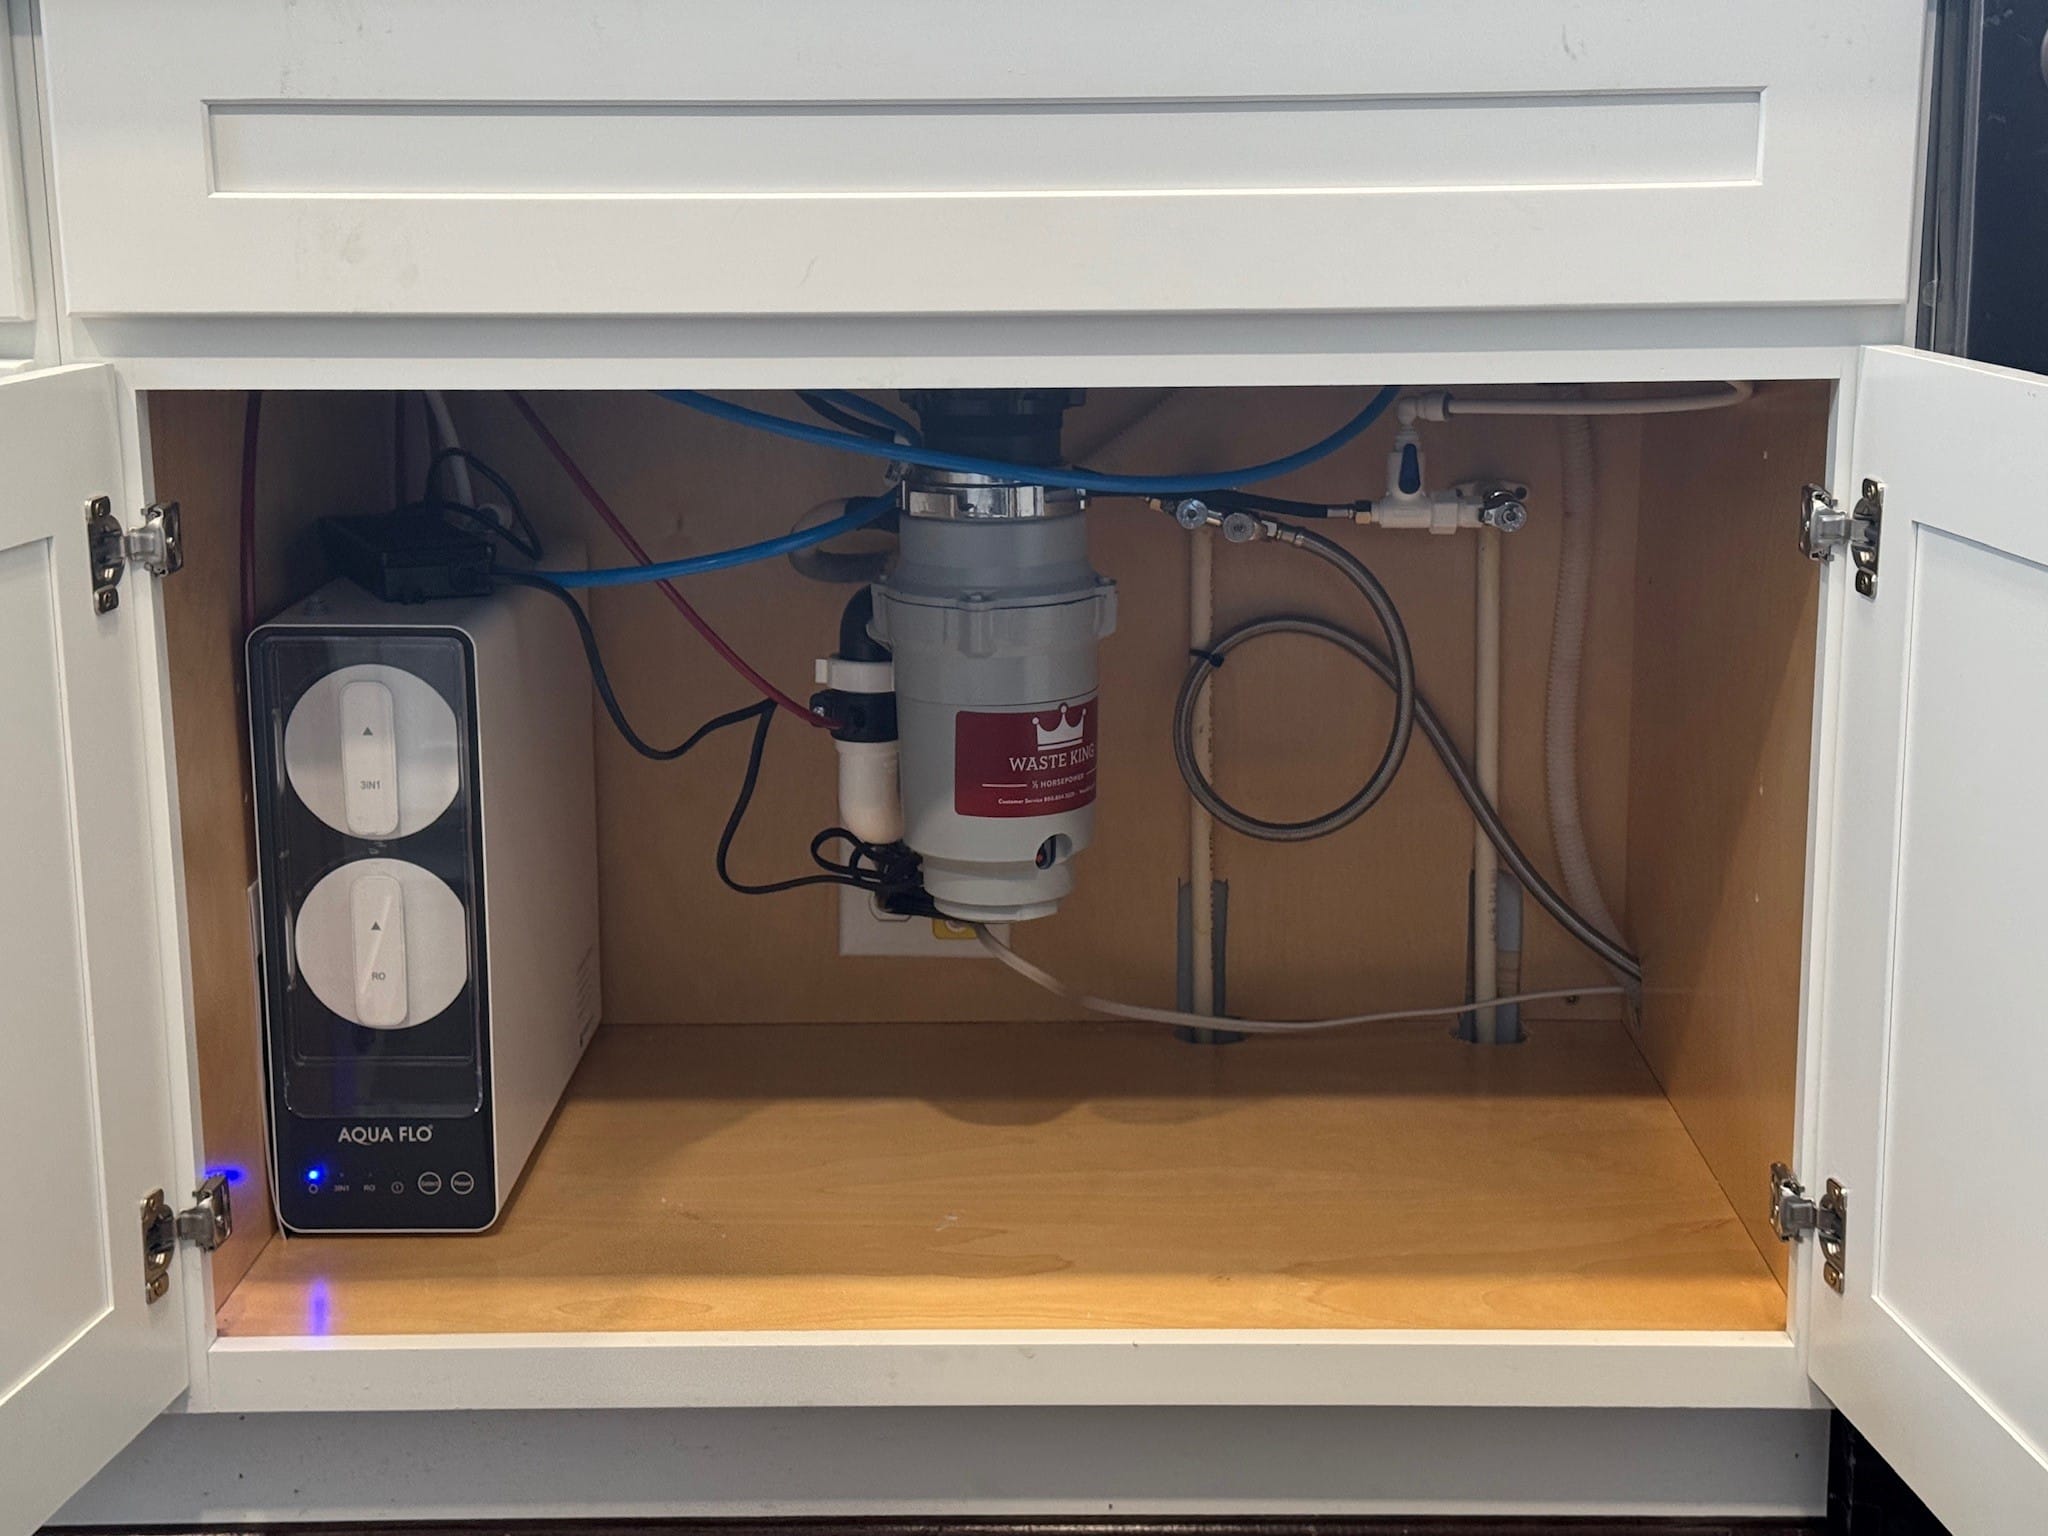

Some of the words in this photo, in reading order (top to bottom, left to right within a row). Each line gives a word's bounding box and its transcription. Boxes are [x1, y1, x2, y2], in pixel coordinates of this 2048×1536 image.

[1009, 753, 1066, 771] WASTE
[1070, 743, 1094, 765] KING
[360, 780, 380, 790] 3IN1
[371, 971, 386, 981] RO
[338, 1127, 393, 1145] AQUA
